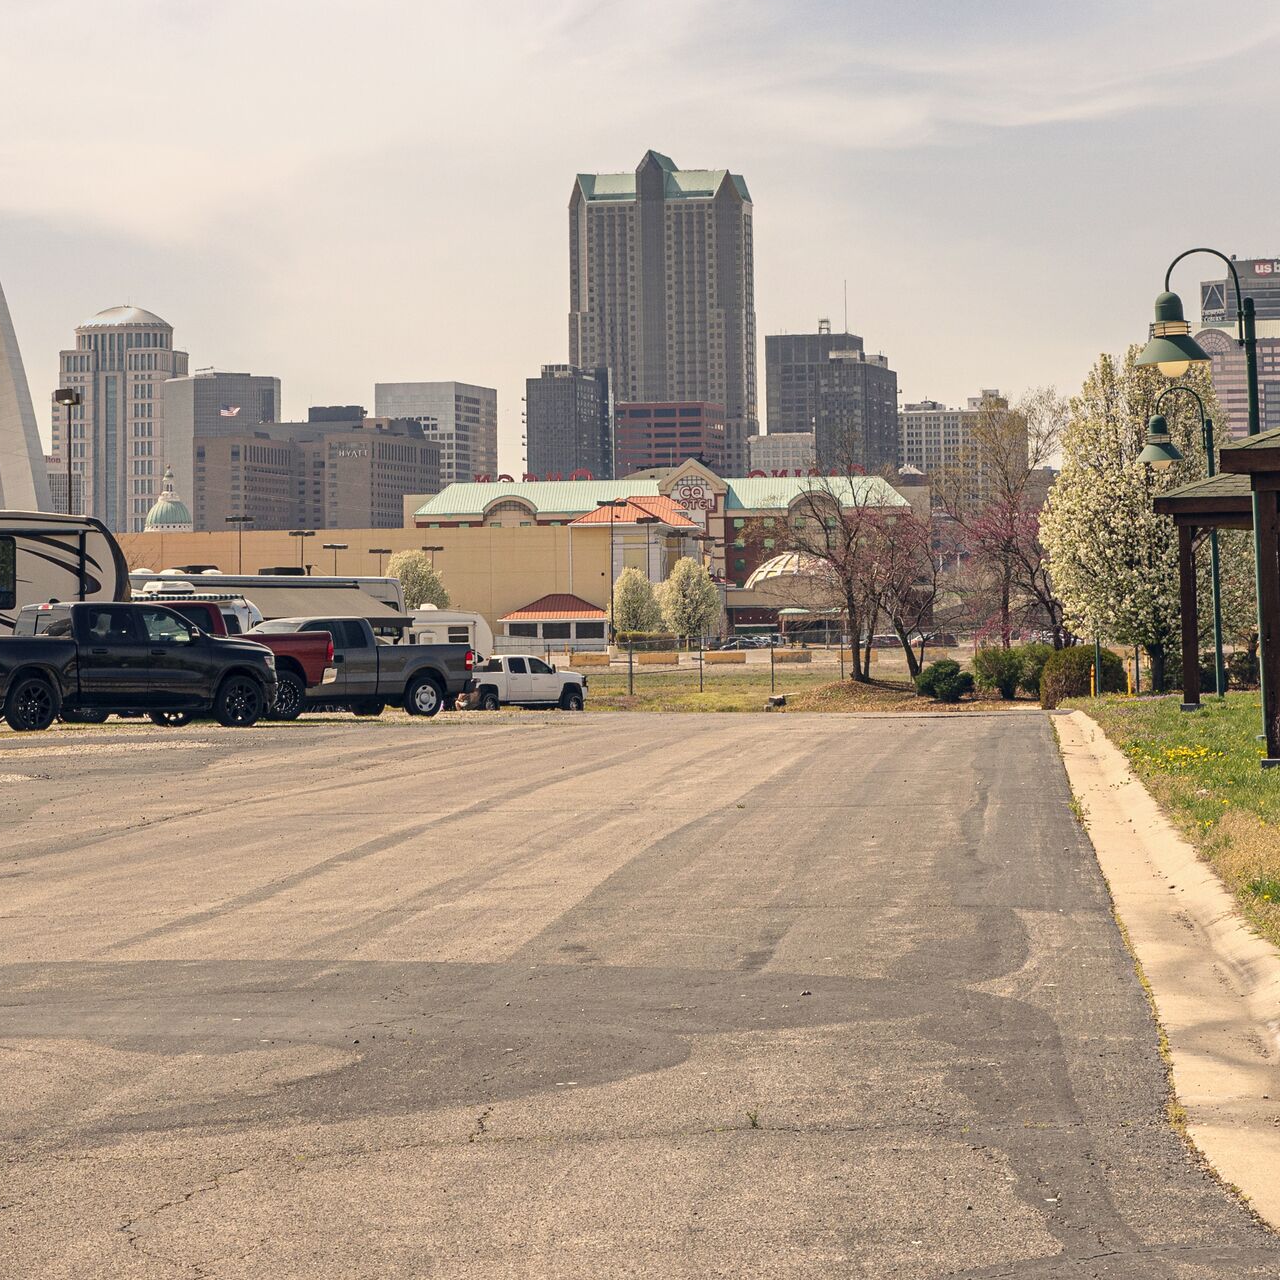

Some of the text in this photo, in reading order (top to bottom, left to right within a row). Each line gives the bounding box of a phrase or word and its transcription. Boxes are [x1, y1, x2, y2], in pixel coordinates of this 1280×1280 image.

[338, 449, 369, 458] HYATT
[45, 455, 62, 464] lton
[679, 486, 704, 499] CQ
[677, 498, 714, 510] OTEL
